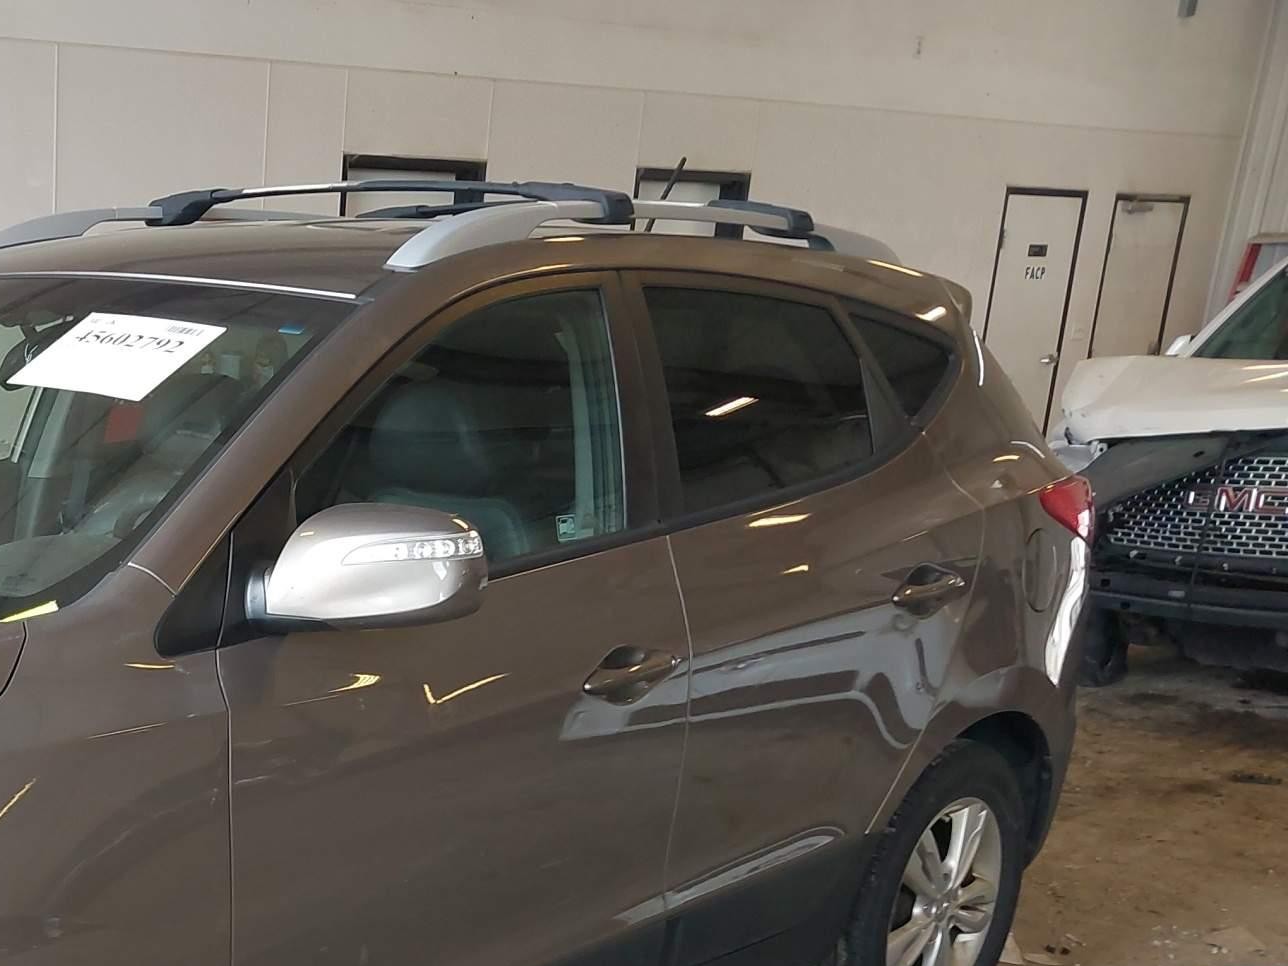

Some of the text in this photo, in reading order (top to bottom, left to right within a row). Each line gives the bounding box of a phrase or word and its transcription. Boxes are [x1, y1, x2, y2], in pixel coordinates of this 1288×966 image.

[1024, 267, 1046, 280] FACP
[75, 329, 185, 354] 45602792
[1183, 486, 1288, 514] GMC
